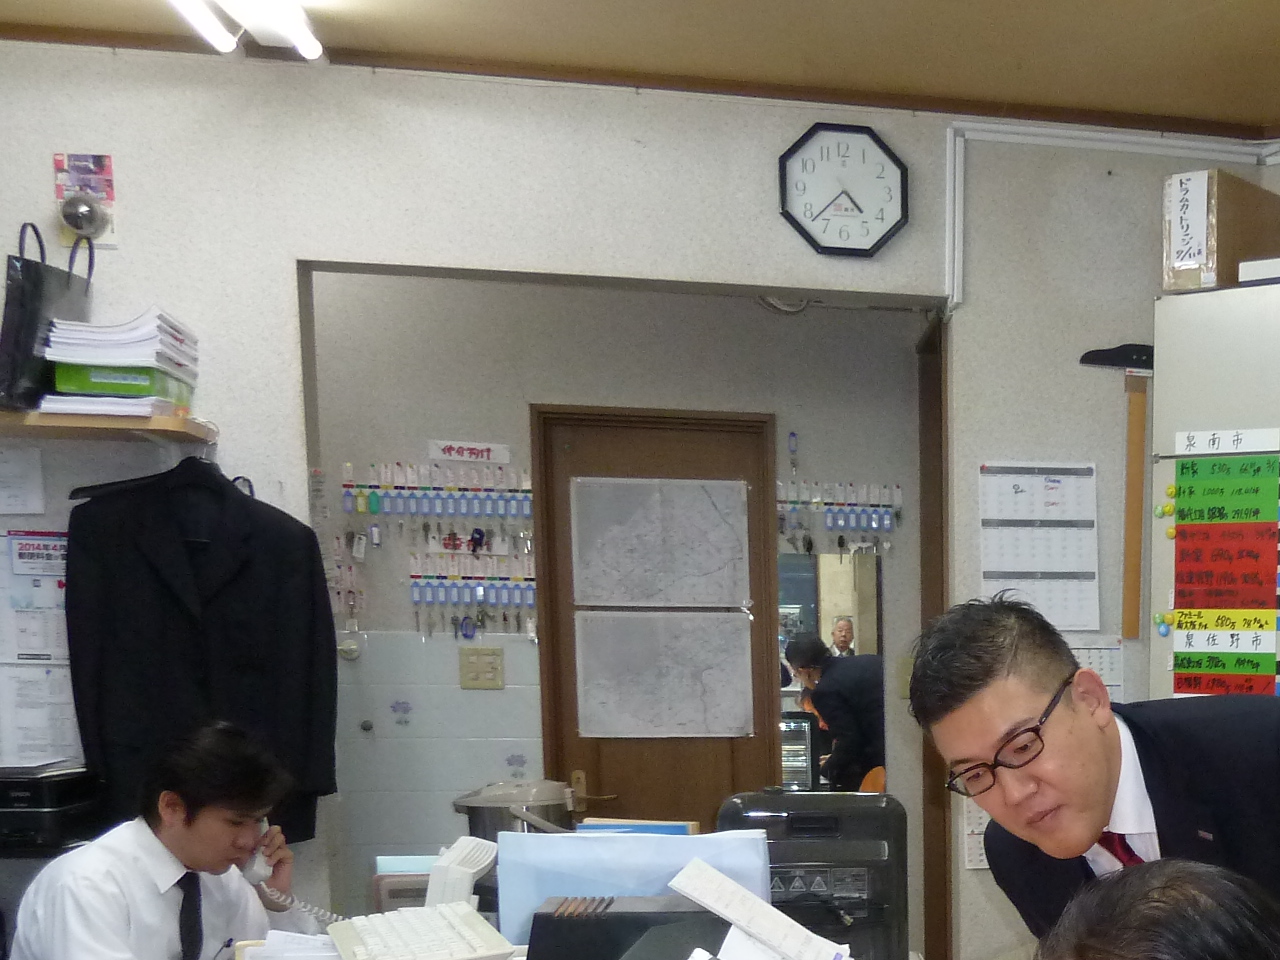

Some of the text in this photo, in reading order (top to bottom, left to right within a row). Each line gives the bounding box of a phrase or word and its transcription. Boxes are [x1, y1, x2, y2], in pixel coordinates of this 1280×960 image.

[820, 146, 830, 162] 11
[837, 142, 850, 158] 12
[801, 158, 816, 174] 10
[876, 163, 885, 179] 2
[795, 181, 806, 197] 9
[884, 186, 893, 202] 3
[803, 203, 813, 219] 8
[875, 208, 885, 223] 4
[821, 218, 831, 234] 7
[838, 225, 850, 241] 6
[860, 220, 870, 237] 5
[1185, 431, 1244, 452] 泉南市
[1185, 632, 1262, 651] 泉佐野市
